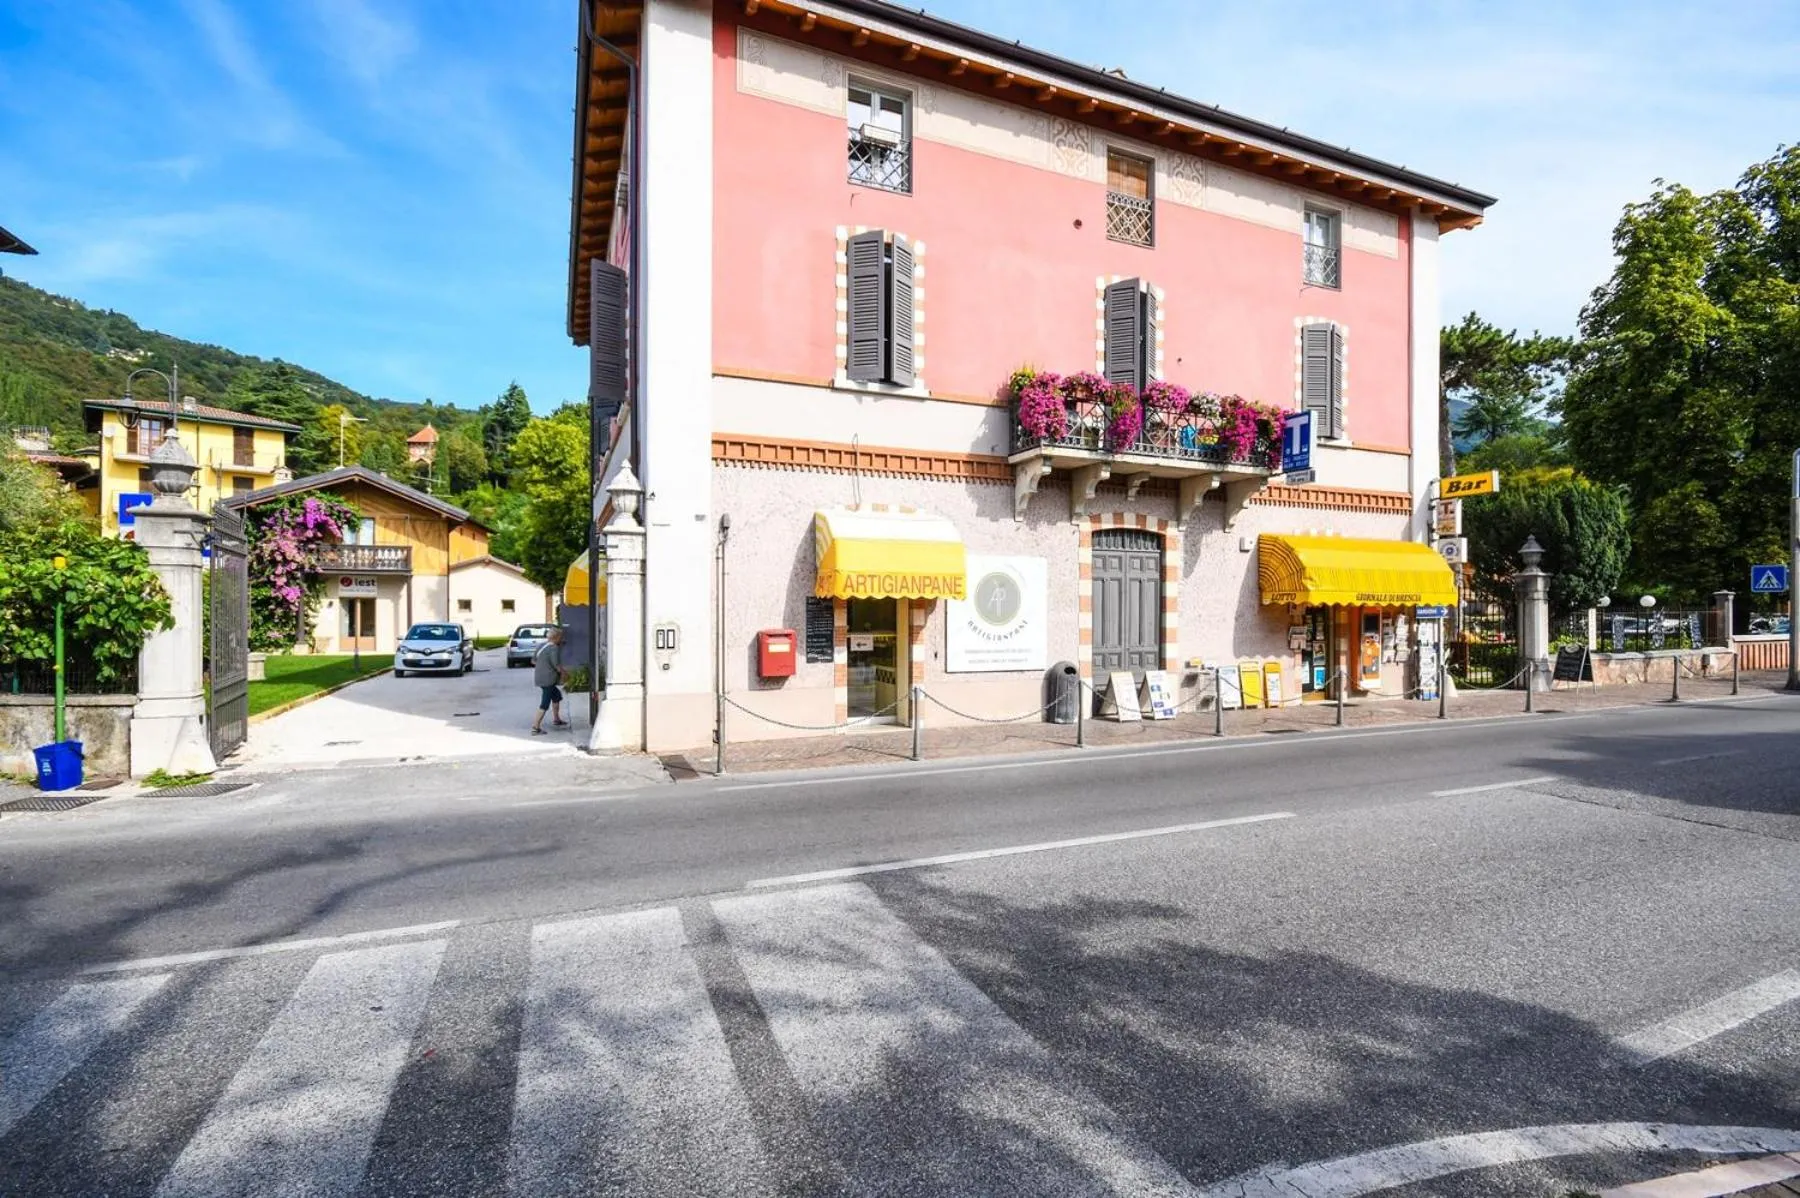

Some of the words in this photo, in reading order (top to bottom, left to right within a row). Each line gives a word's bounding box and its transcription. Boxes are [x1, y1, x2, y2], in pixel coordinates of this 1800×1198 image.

[1446, 479, 1487, 494] Bar
[844, 574, 963, 594] ARTIGIANPANE
[1271, 593, 1297, 601] LOTTO
